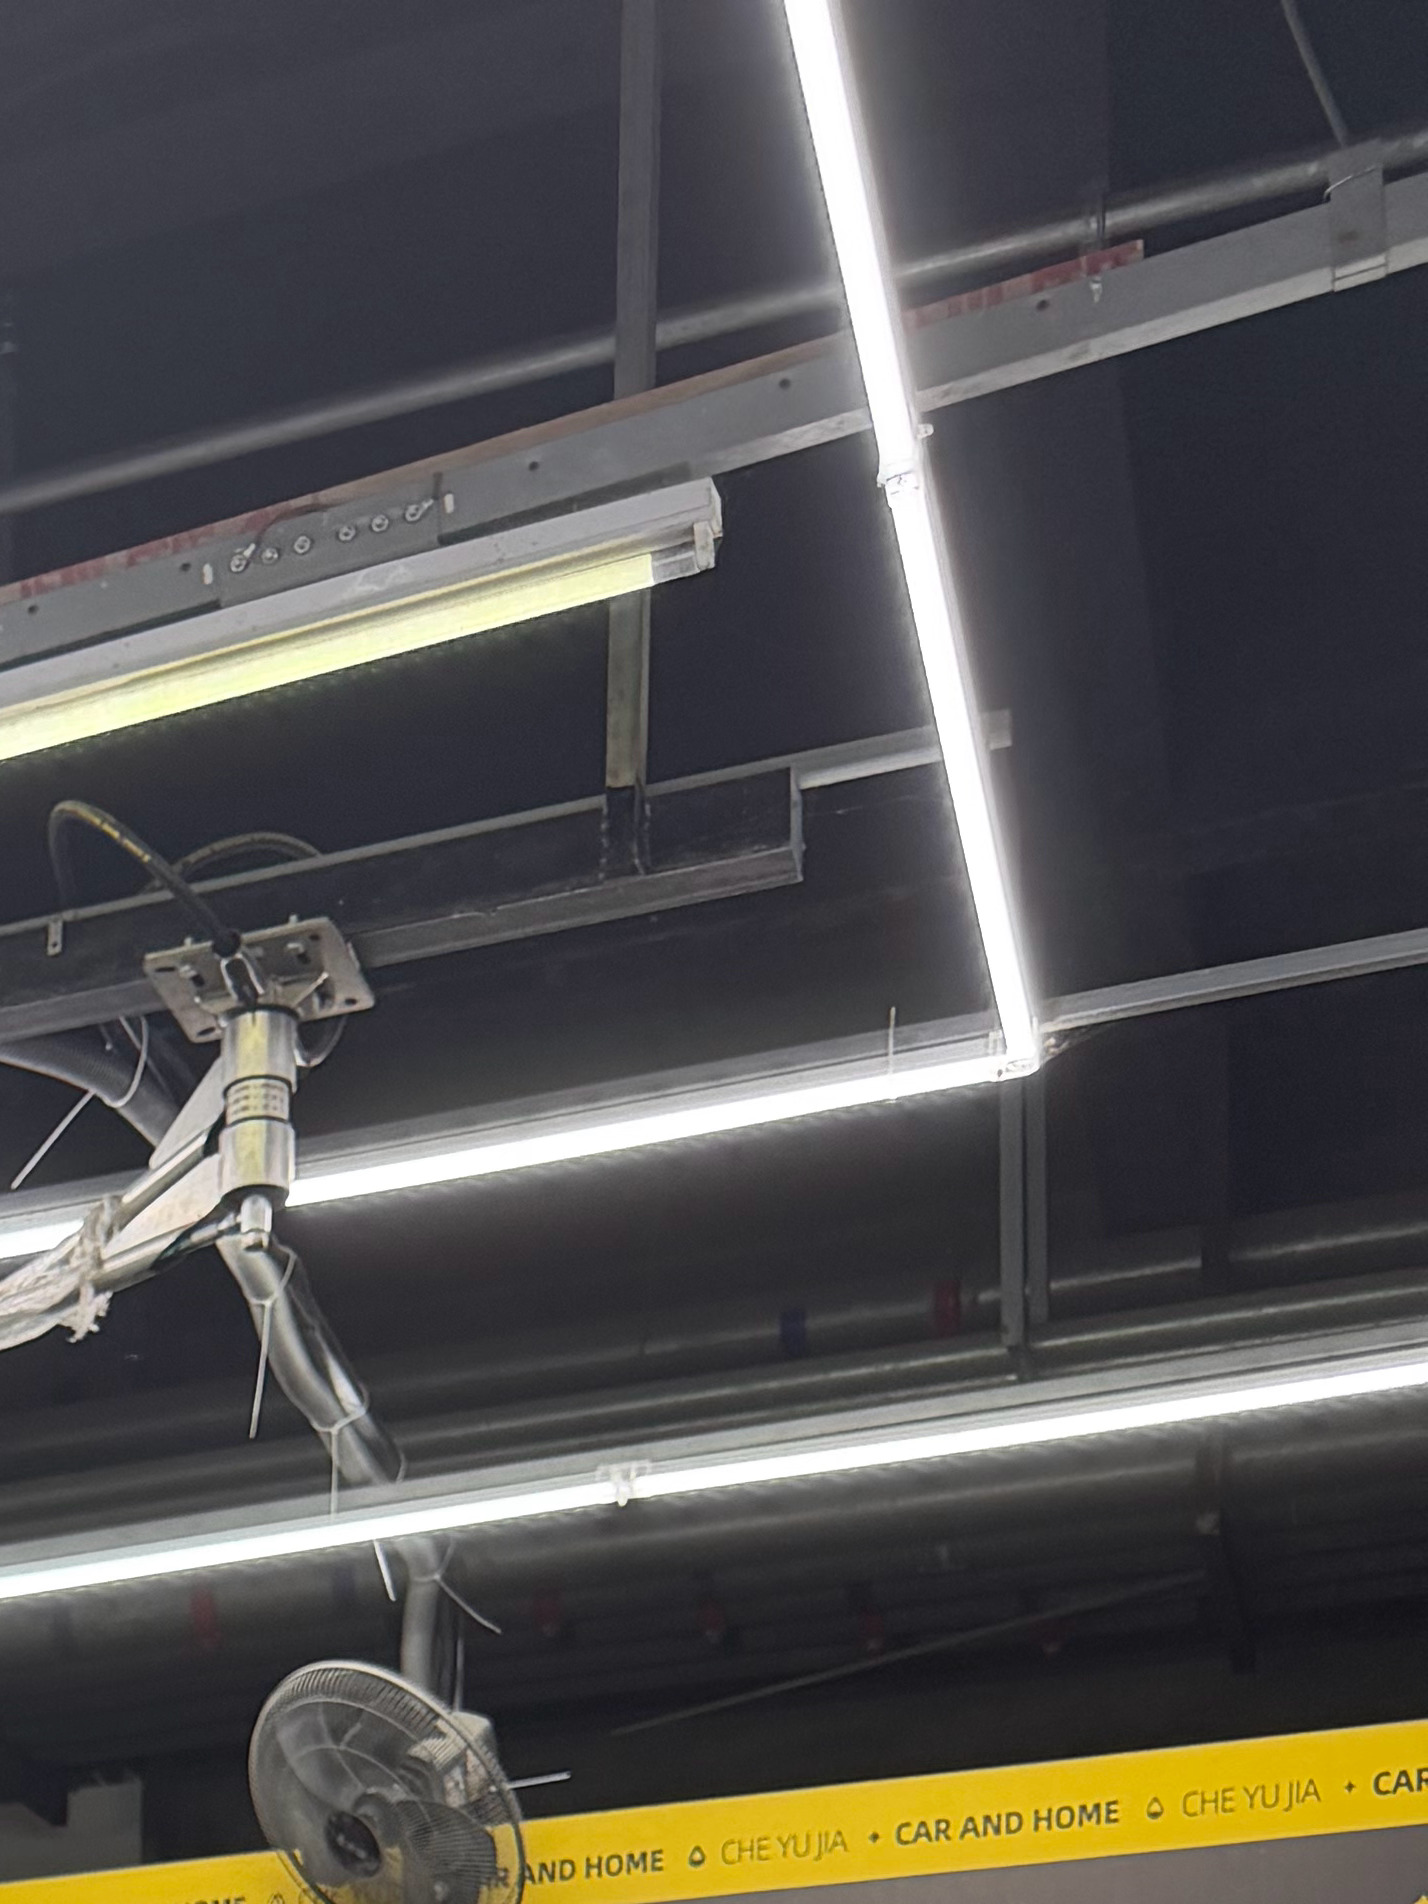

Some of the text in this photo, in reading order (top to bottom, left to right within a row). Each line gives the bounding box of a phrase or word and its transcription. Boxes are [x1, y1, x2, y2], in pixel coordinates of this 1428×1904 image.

[1372, 1767, 1428, 1797] CAR
[895, 1799, 1120, 1846] CAR AND HOME
[522, 1858, 575, 1886] AND
[584, 1849, 664, 1879] HOME
